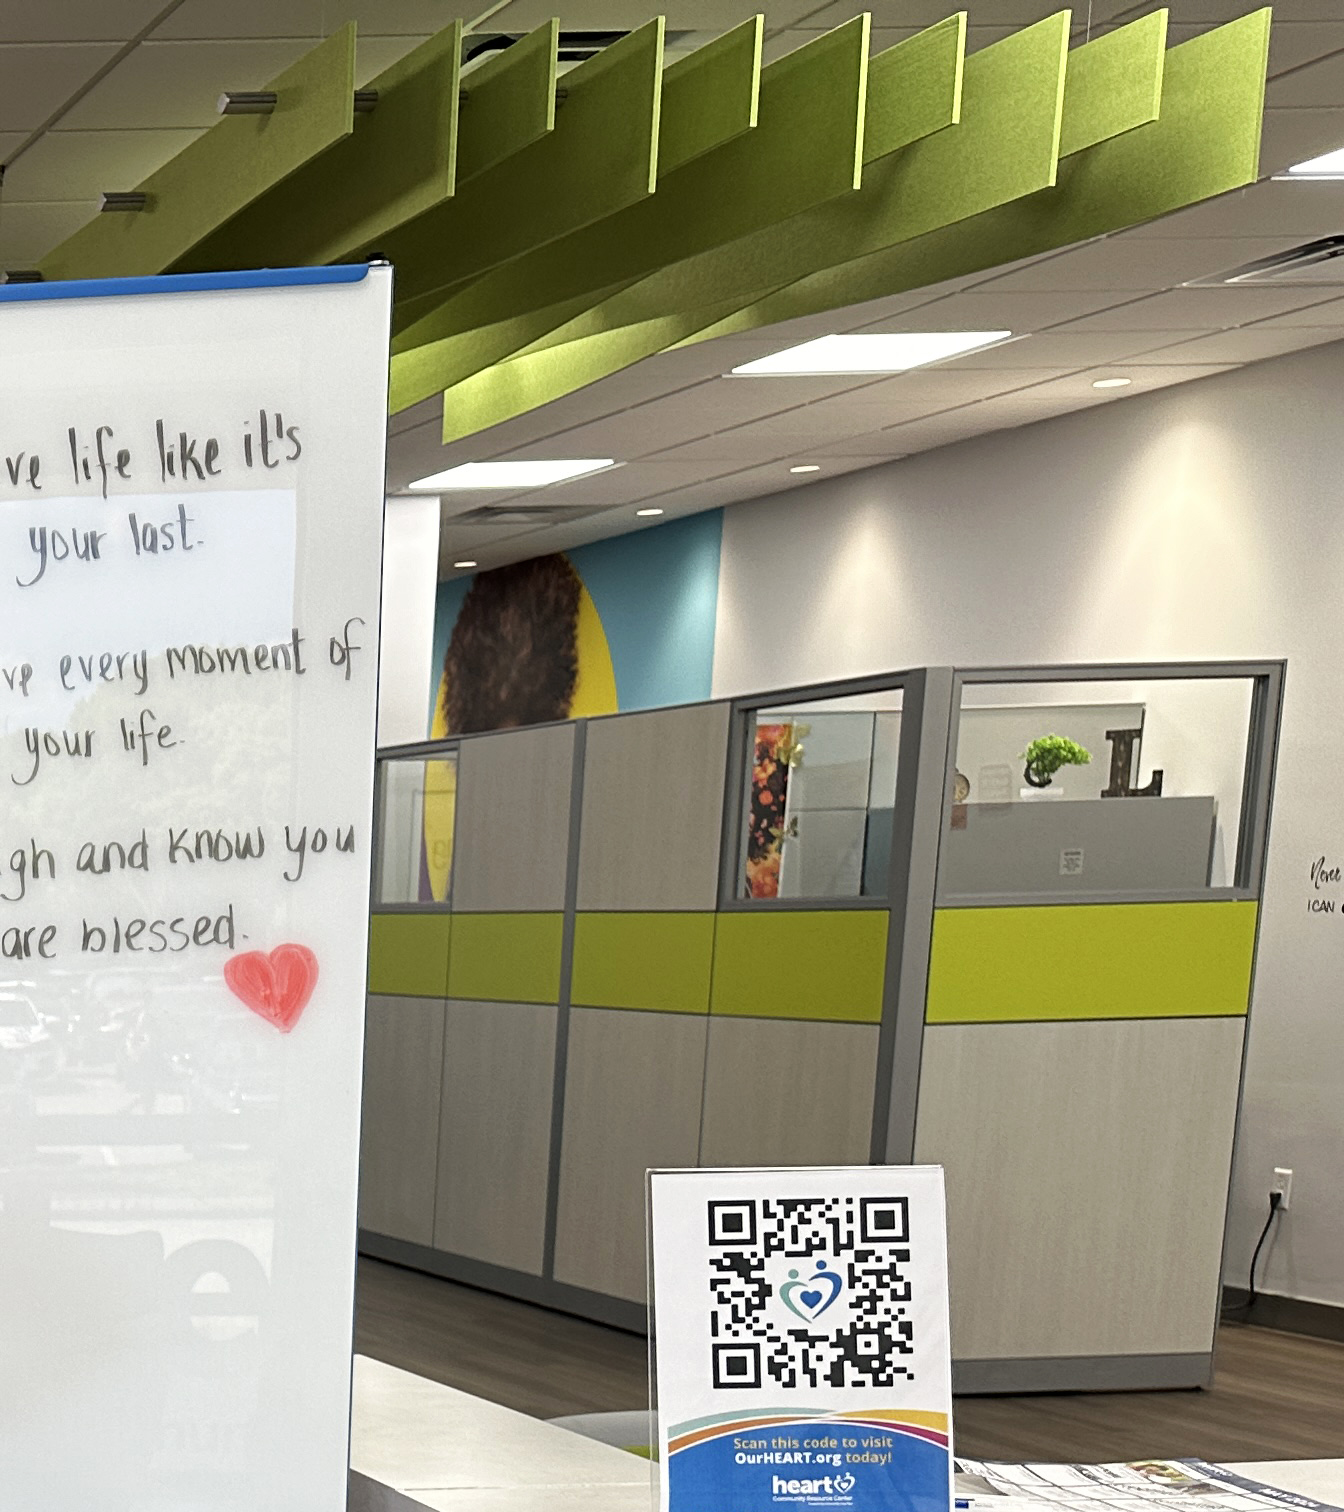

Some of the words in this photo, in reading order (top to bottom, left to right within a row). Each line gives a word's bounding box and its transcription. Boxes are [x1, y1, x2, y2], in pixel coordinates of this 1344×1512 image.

[68, 425, 132, 499] life
[155, 419, 223, 483] like
[244, 409, 303, 469] it's
[16, 526, 108, 588] your
[129, 504, 204, 555] last.
[59, 642, 149, 696] every
[166, 627, 307, 679] moment
[330, 617, 366, 680] of
[11, 727, 95, 786] your
[75, 834, 150, 876] and
[283, 824, 356, 883] you
[1, 924, 57, 960] are
[81, 903, 249, 954] blessed.
[733, 1437, 768, 1449] Scan
[771, 1436, 800, 1449] this
[803, 1436, 838, 1449] code
[842, 1437, 858, 1448] to
[861, 1436, 893, 1448] visit
[734, 1452, 842, 1466] OurHEART.org
[845, 1451, 892, 1466] today!
[772, 1475, 834, 1494] heart
